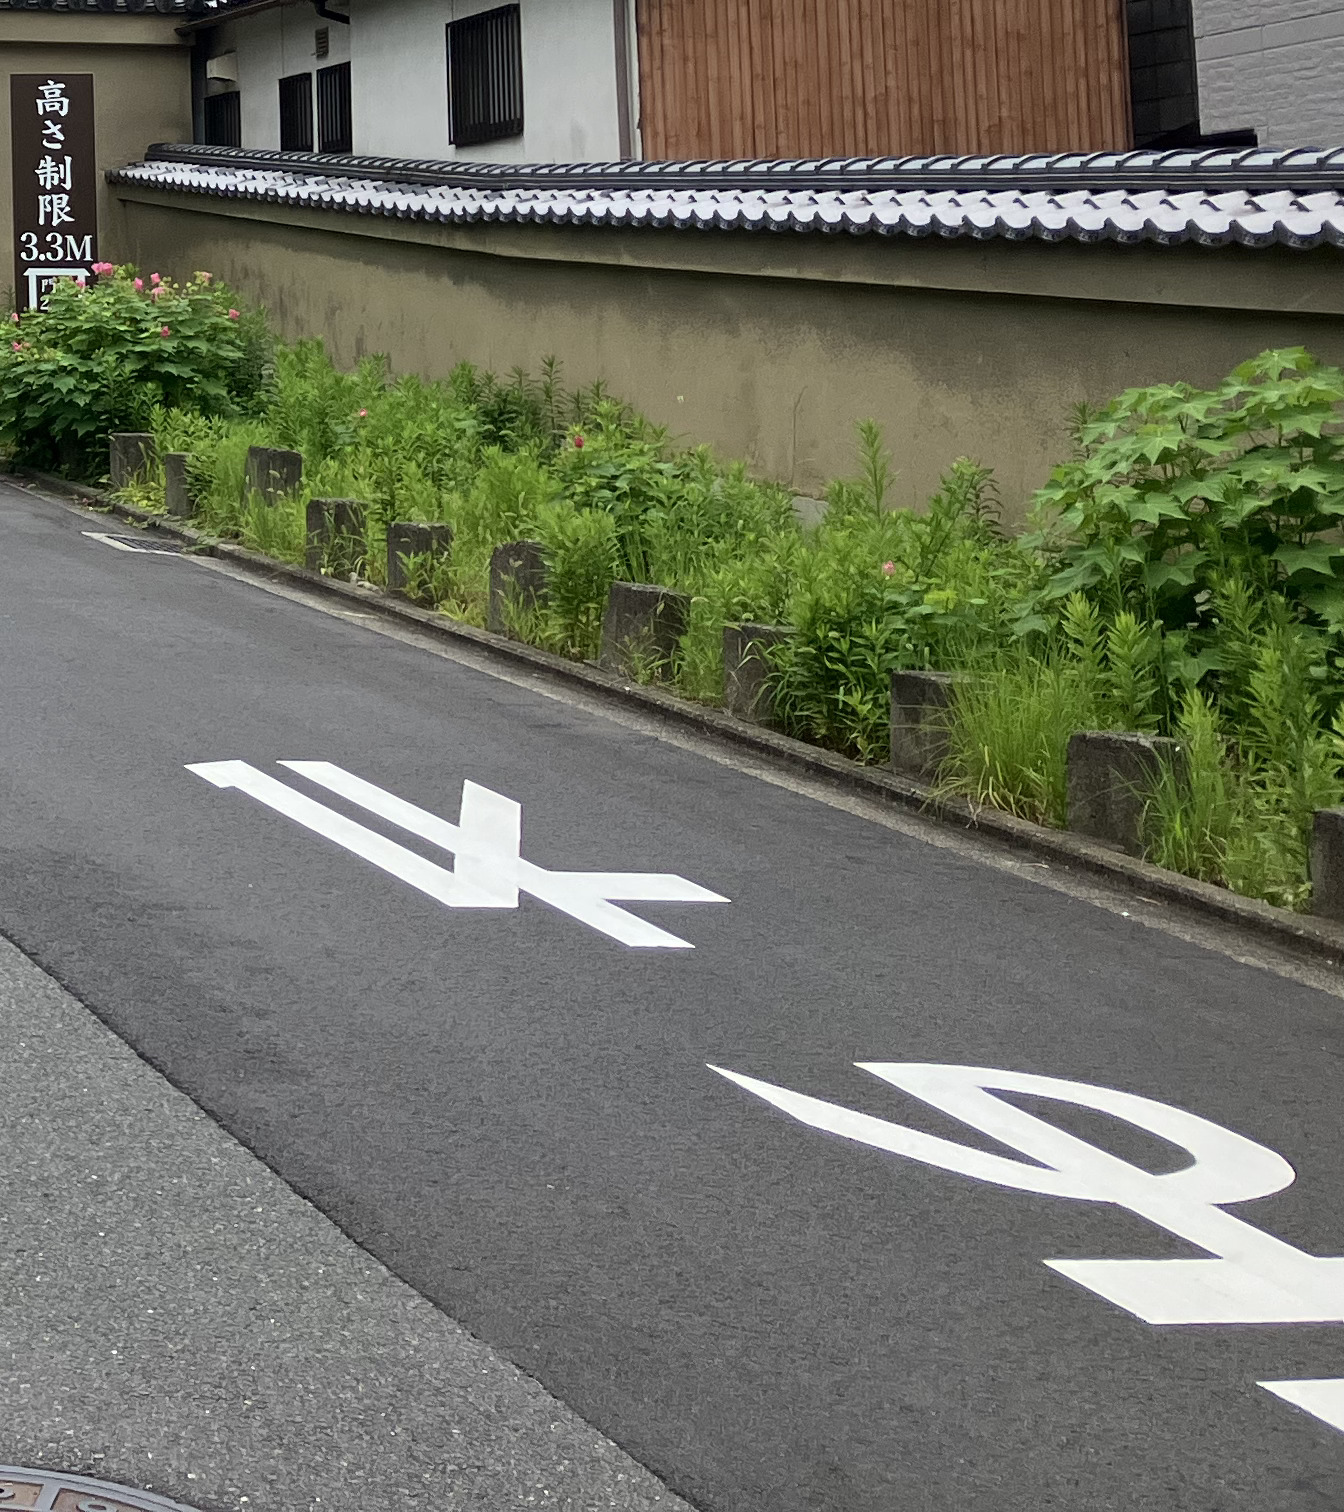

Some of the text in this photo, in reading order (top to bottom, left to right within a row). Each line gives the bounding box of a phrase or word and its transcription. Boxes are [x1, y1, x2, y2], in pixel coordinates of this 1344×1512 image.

[35, 80, 75, 226] 高さ制限
[21, 232, 93, 261] 3.3M
